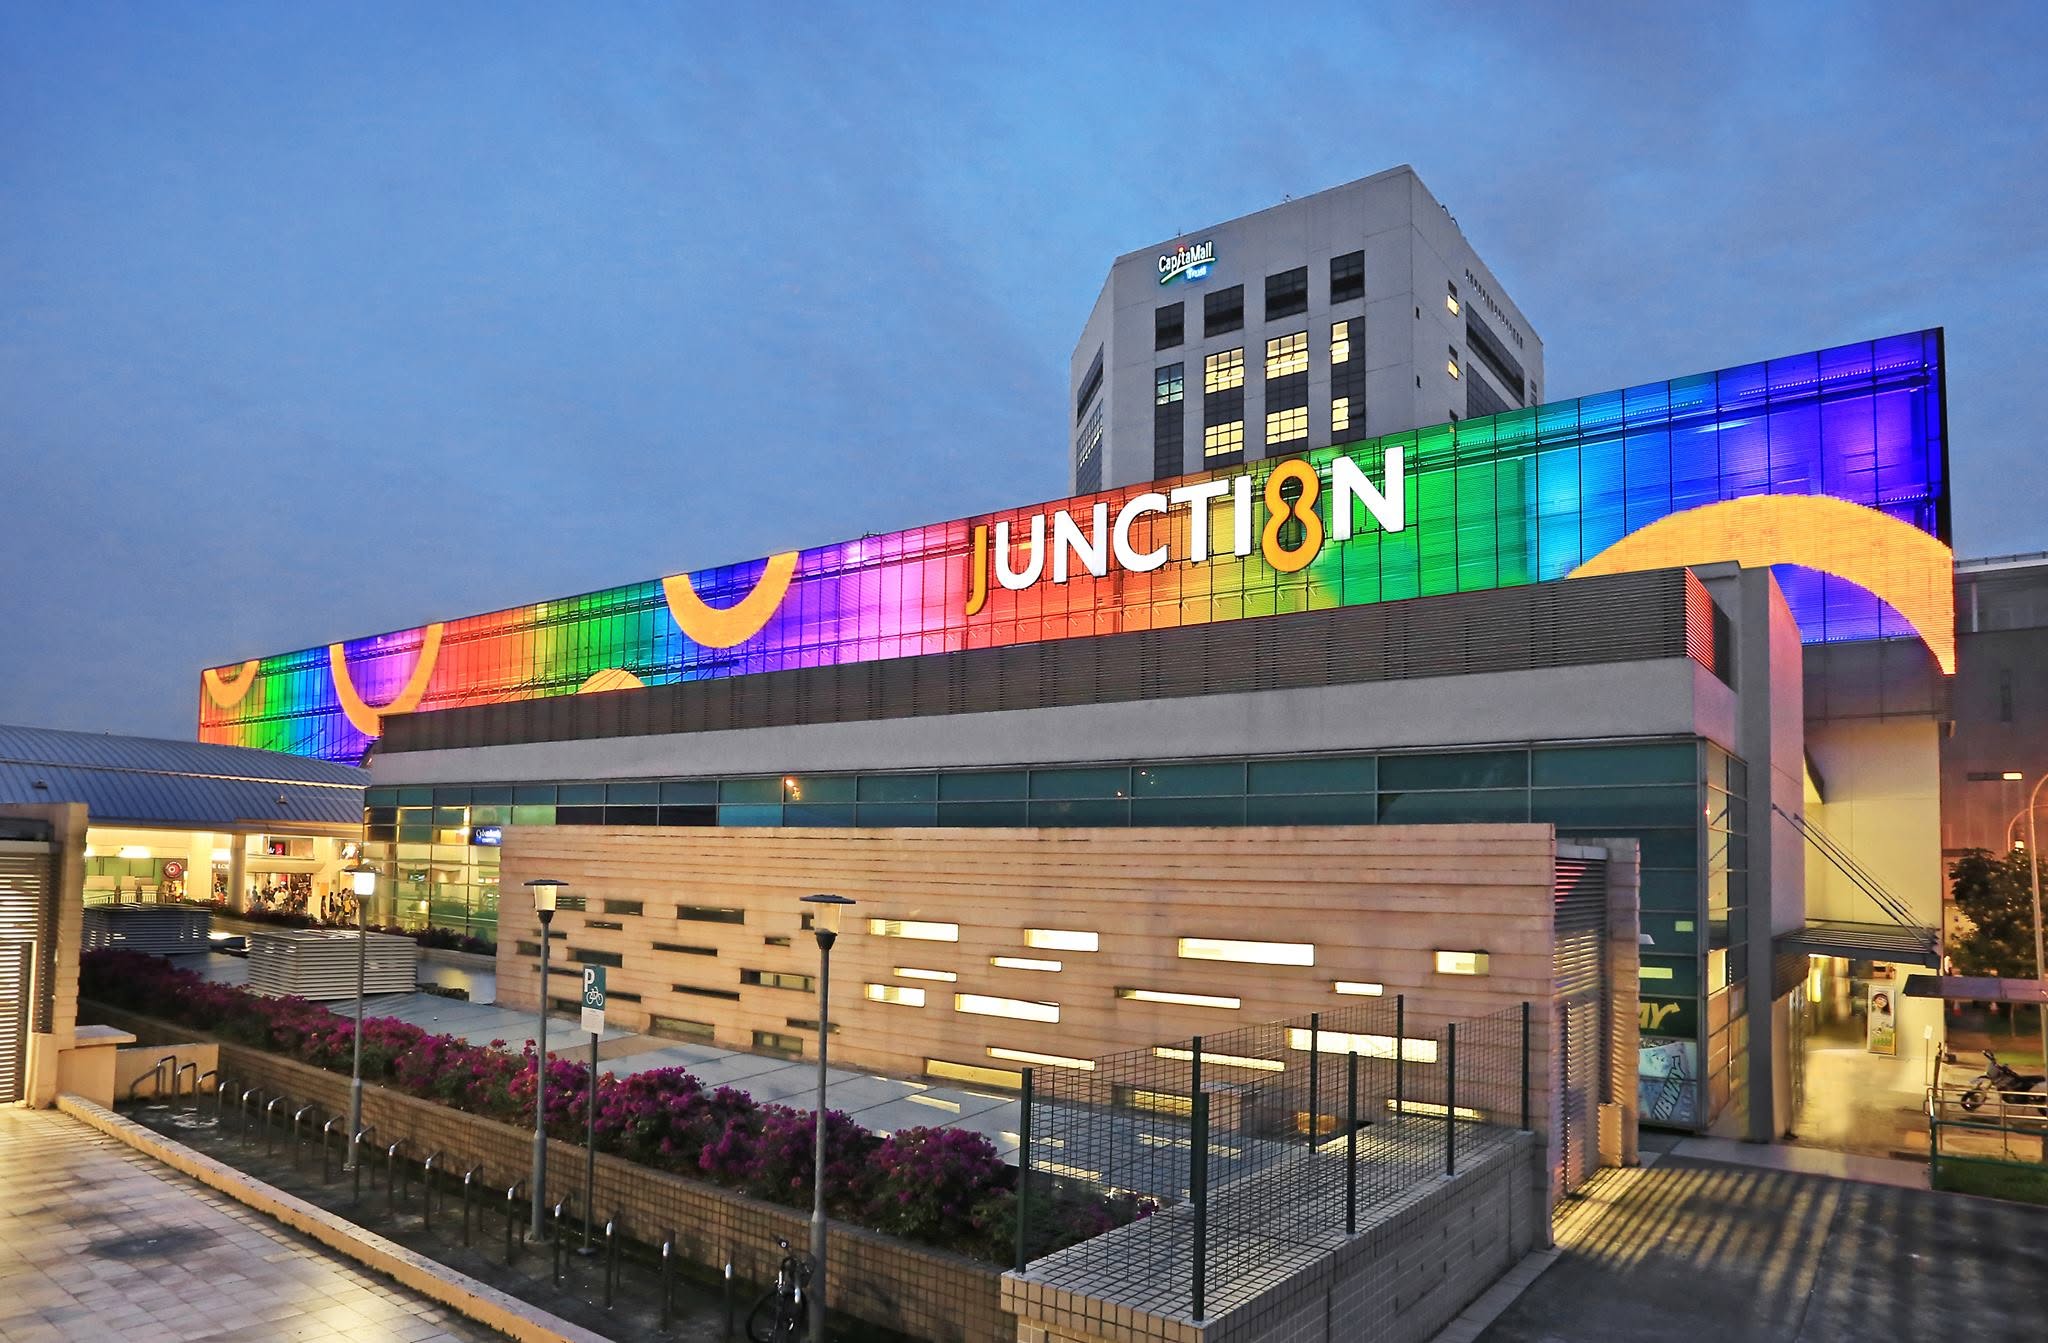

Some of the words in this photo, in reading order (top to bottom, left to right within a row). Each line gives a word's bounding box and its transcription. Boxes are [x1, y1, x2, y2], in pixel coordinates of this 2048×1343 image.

[1158, 241, 1213, 273] CapitaMall
[1185, 266, 1207, 279] Trust
[583, 968, 596, 993] P
[1650, 1056, 1687, 1121] UBWAY
